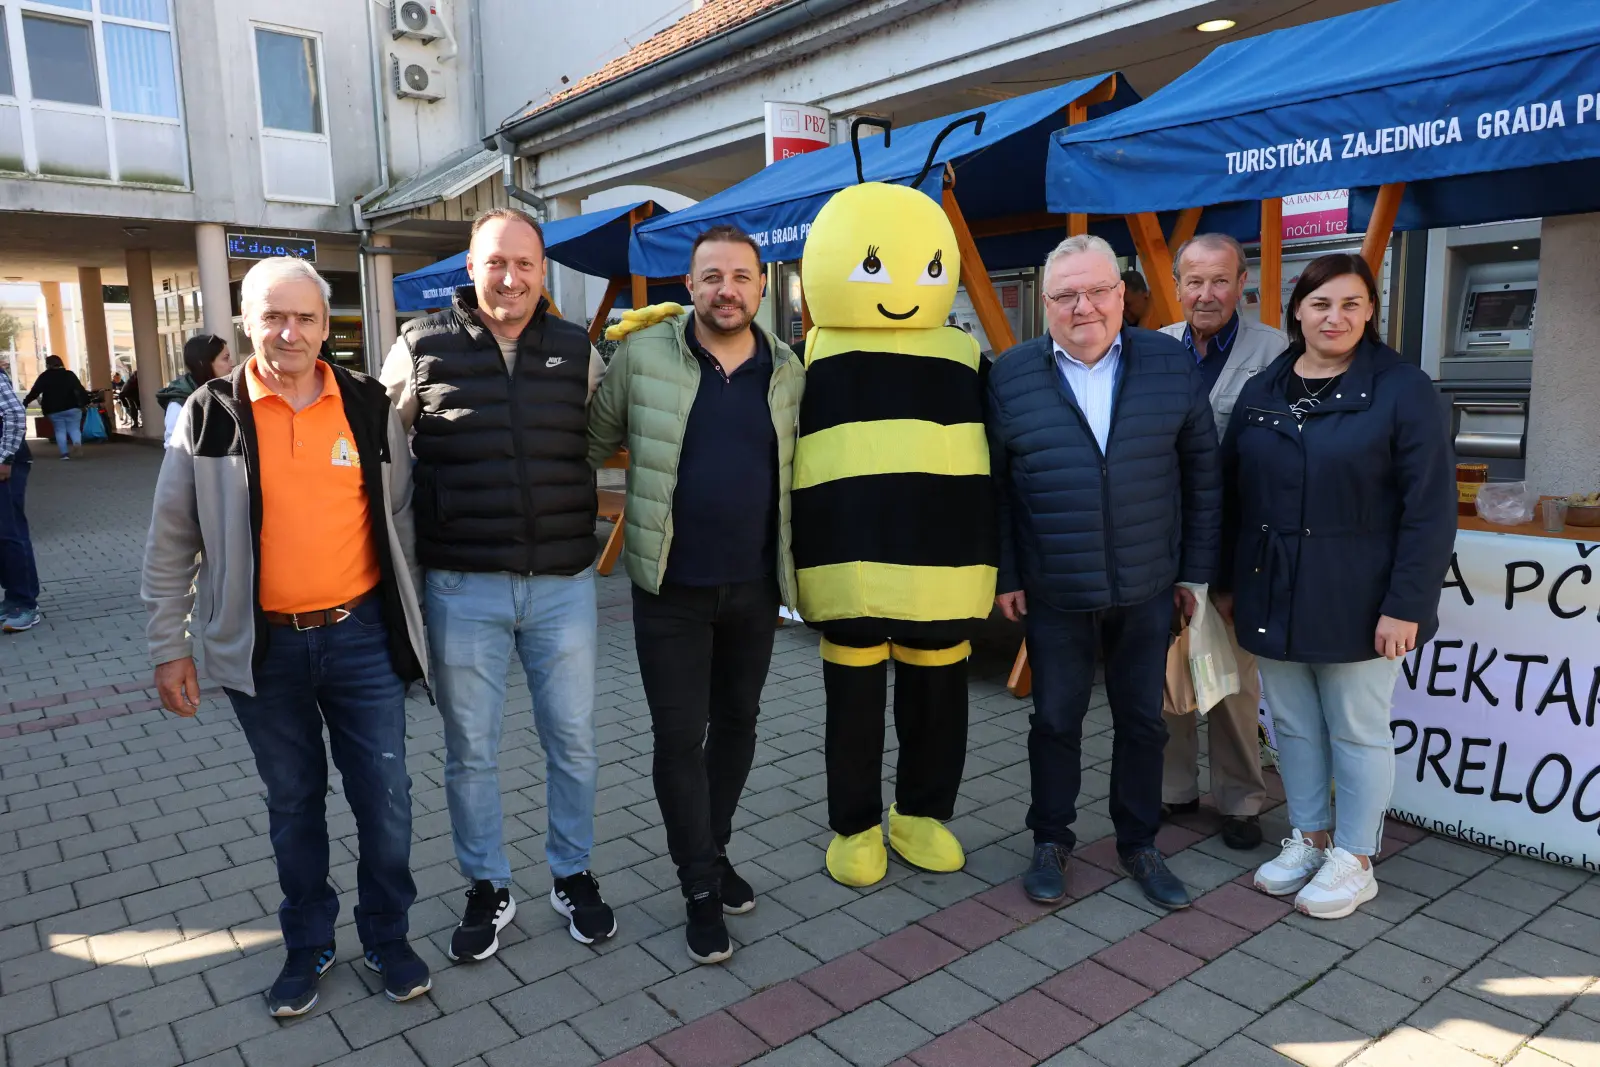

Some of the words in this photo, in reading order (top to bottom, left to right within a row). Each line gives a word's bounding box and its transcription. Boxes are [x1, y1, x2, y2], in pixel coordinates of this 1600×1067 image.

[804, 115, 826, 134] PBZ
[1226, 138, 1332, 175] TURISTIČKA
[1342, 117, 1462, 160] ZAJEDNICA
[1477, 100, 1565, 139] GRADA
[1577, 93, 1600, 124] P
[1297, 191, 1331, 205] BANKA
[772, 225, 798, 244] GRADA
[1286, 221, 1321, 237] noćni
[1505, 542, 1600, 623] PČ
